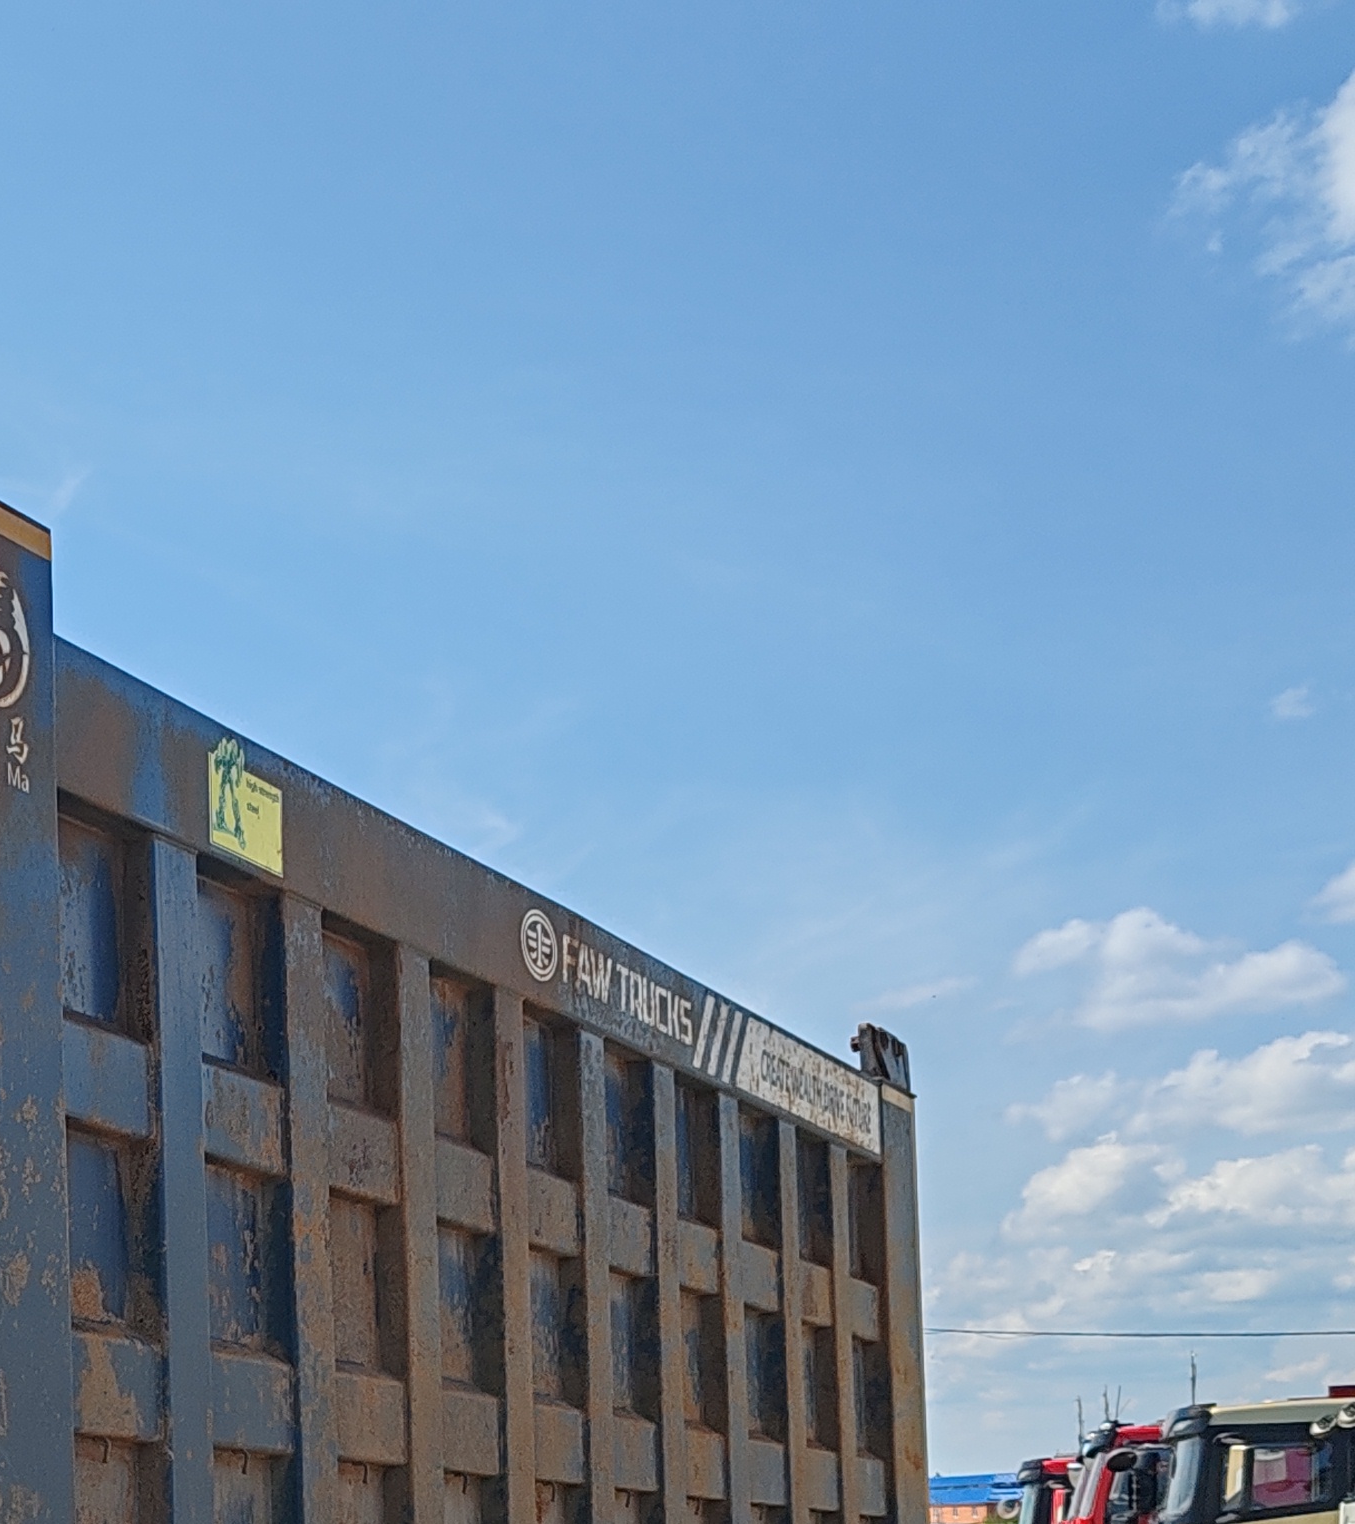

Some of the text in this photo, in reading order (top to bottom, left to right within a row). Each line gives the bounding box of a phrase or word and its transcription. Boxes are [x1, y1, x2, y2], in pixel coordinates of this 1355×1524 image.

[7, 762, 30, 794] Ma
[562, 933, 693, 1046] FAW TRUCKS
